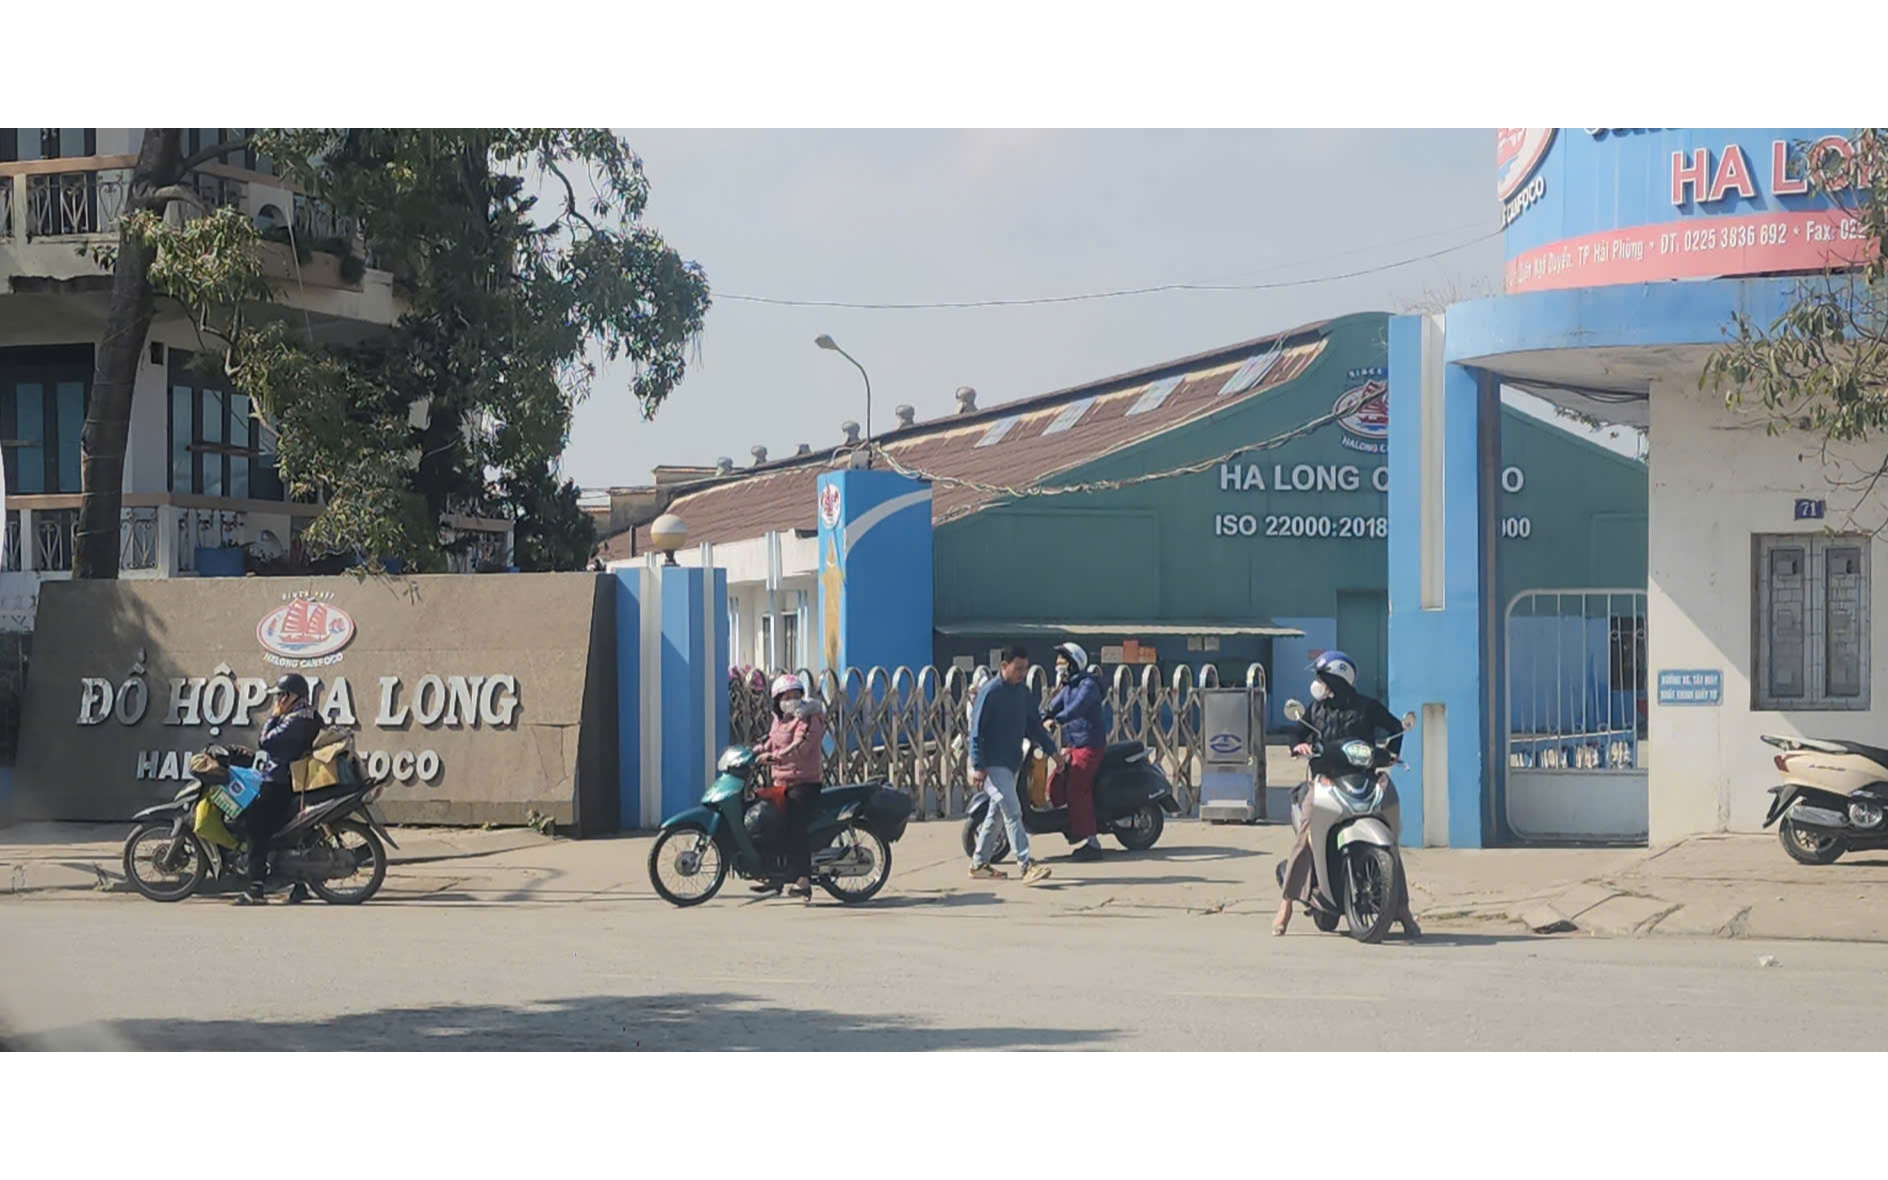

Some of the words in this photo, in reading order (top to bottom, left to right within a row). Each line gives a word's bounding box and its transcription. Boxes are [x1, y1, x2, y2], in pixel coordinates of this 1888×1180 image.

[1671, 144, 1756, 206] HA
[1684, 229, 1716, 252] 0225
[1720, 225, 1755, 249] 3836
[1760, 223, 1787, 246] 692
[1220, 464, 1265, 491] HA
[1274, 465, 1360, 492] LONG
[1800, 501, 1817, 517] 71
[1215, 515, 1257, 536] ISO
[1264, 516, 1388, 538] 22000:2018
[76, 647, 149, 726] ĐỒ
[162, 661, 268, 736] HỘP
[375, 674, 519, 726] LONG
